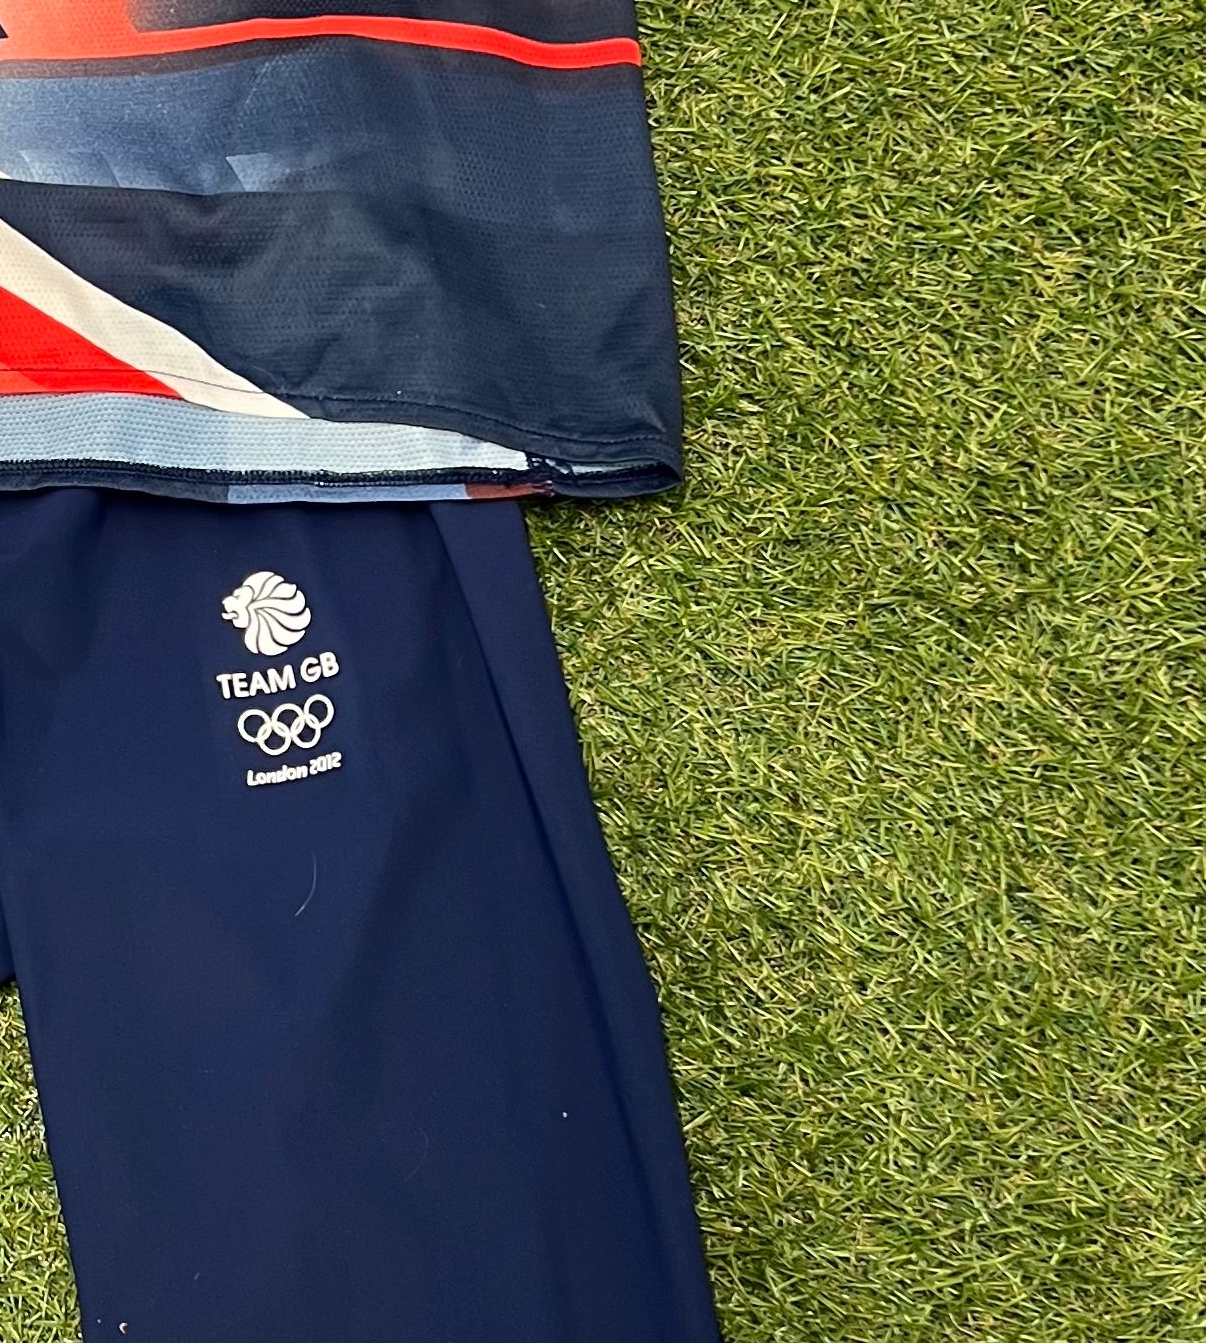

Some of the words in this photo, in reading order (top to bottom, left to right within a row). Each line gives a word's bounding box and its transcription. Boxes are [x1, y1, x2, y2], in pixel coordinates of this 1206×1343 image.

[216, 664, 297, 699] TEAM
[300, 652, 340, 683] GB
[247, 764, 308, 787] London
[309, 751, 342, 774] 2012
